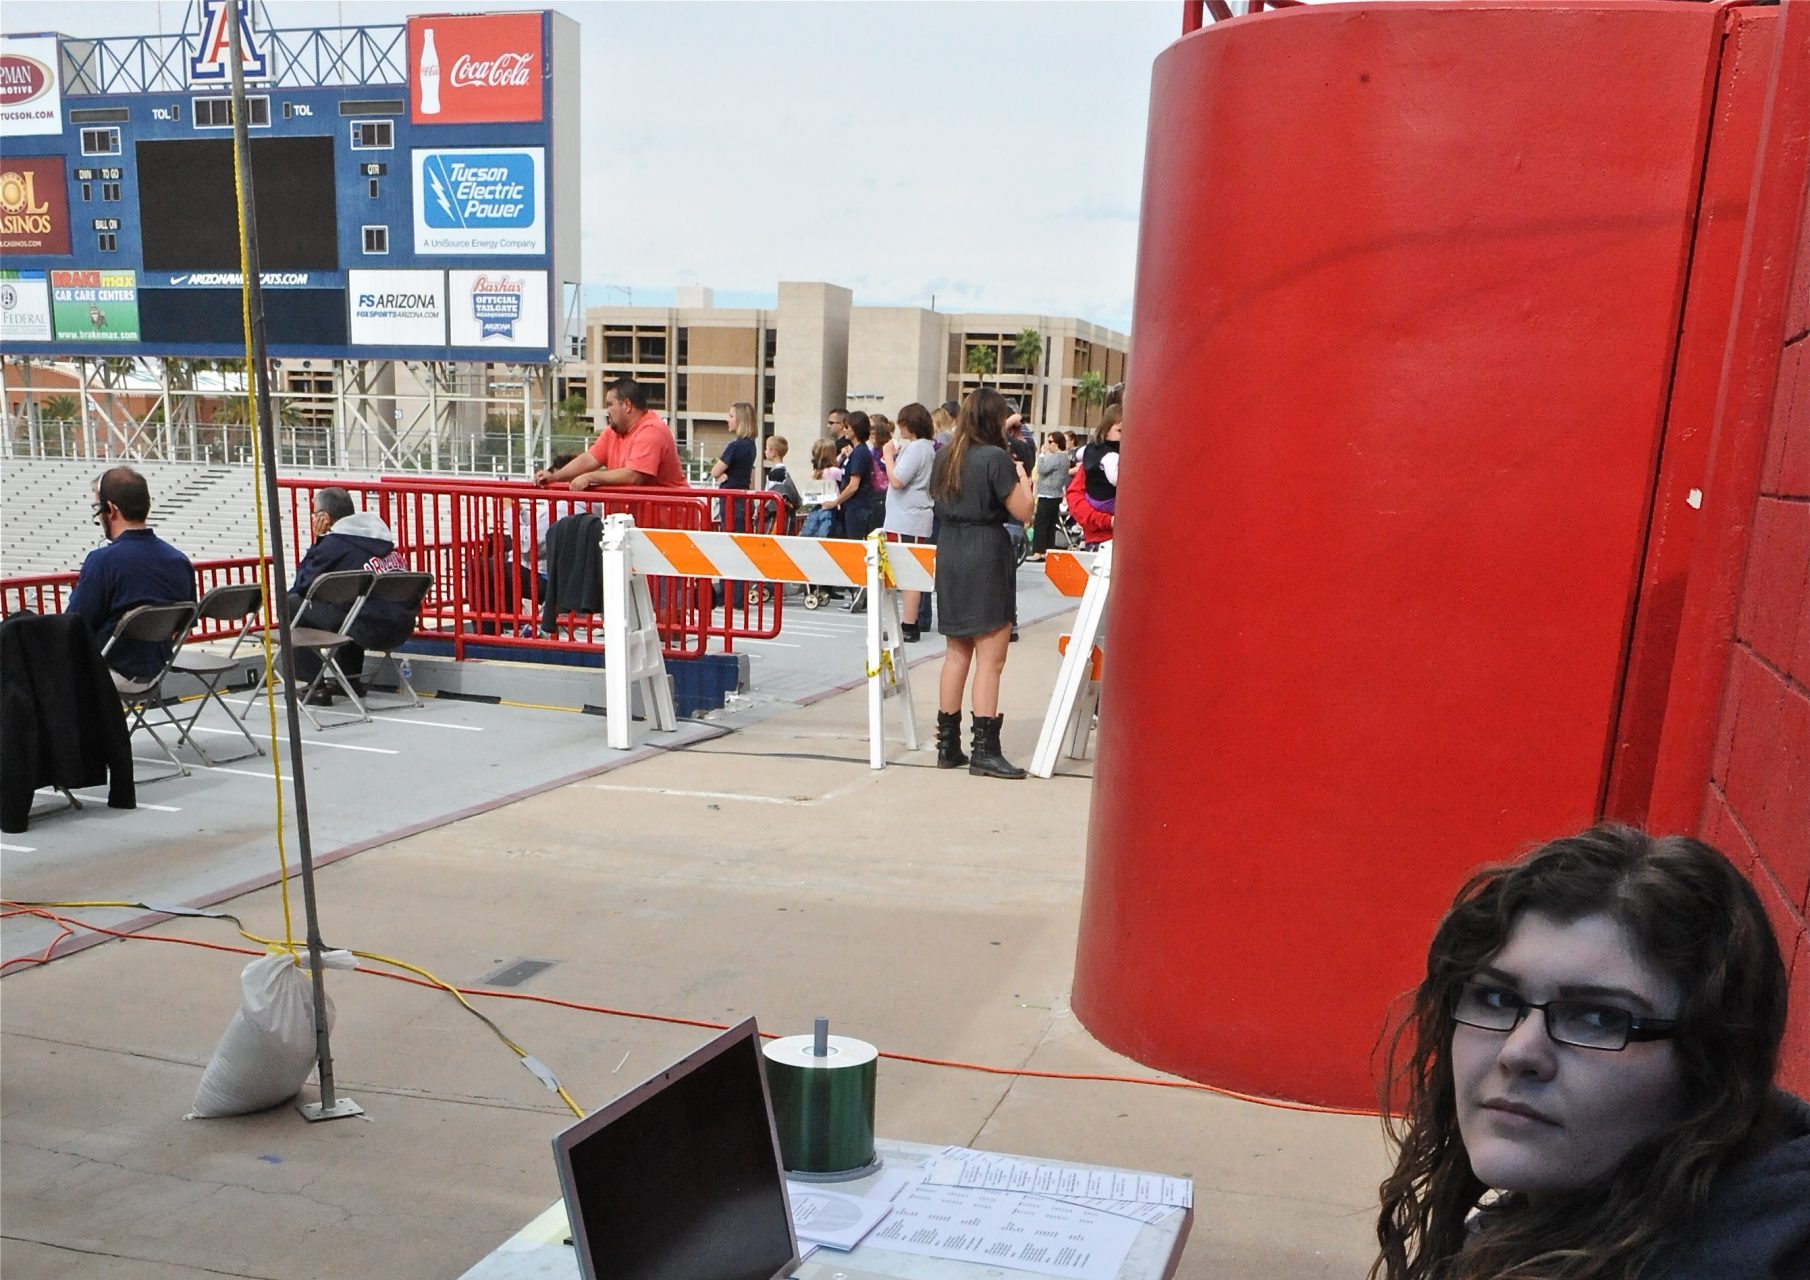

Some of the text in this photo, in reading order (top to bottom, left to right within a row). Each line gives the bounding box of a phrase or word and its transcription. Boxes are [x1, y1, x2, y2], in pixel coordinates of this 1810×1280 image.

[450, 53, 534, 88] Coca-Cola
[152, 109, 171, 120] TOL
[294, 105, 313, 116] TOL
[450, 163, 508, 182] Tucson
[456, 182, 524, 200] Electric
[464, 200, 524, 218] Power
[423, 239, 536, 249] A UniSource Energy Company
[188, 273, 308, 285] ARIZONAWCATS.COM
[55, 290, 135, 301] CAR CARE CENTERS
[475, 296, 518, 304] OFFICIAL
[358, 294, 435, 309] FS ARIZONA
[475, 304, 518, 312] TAILGATE
